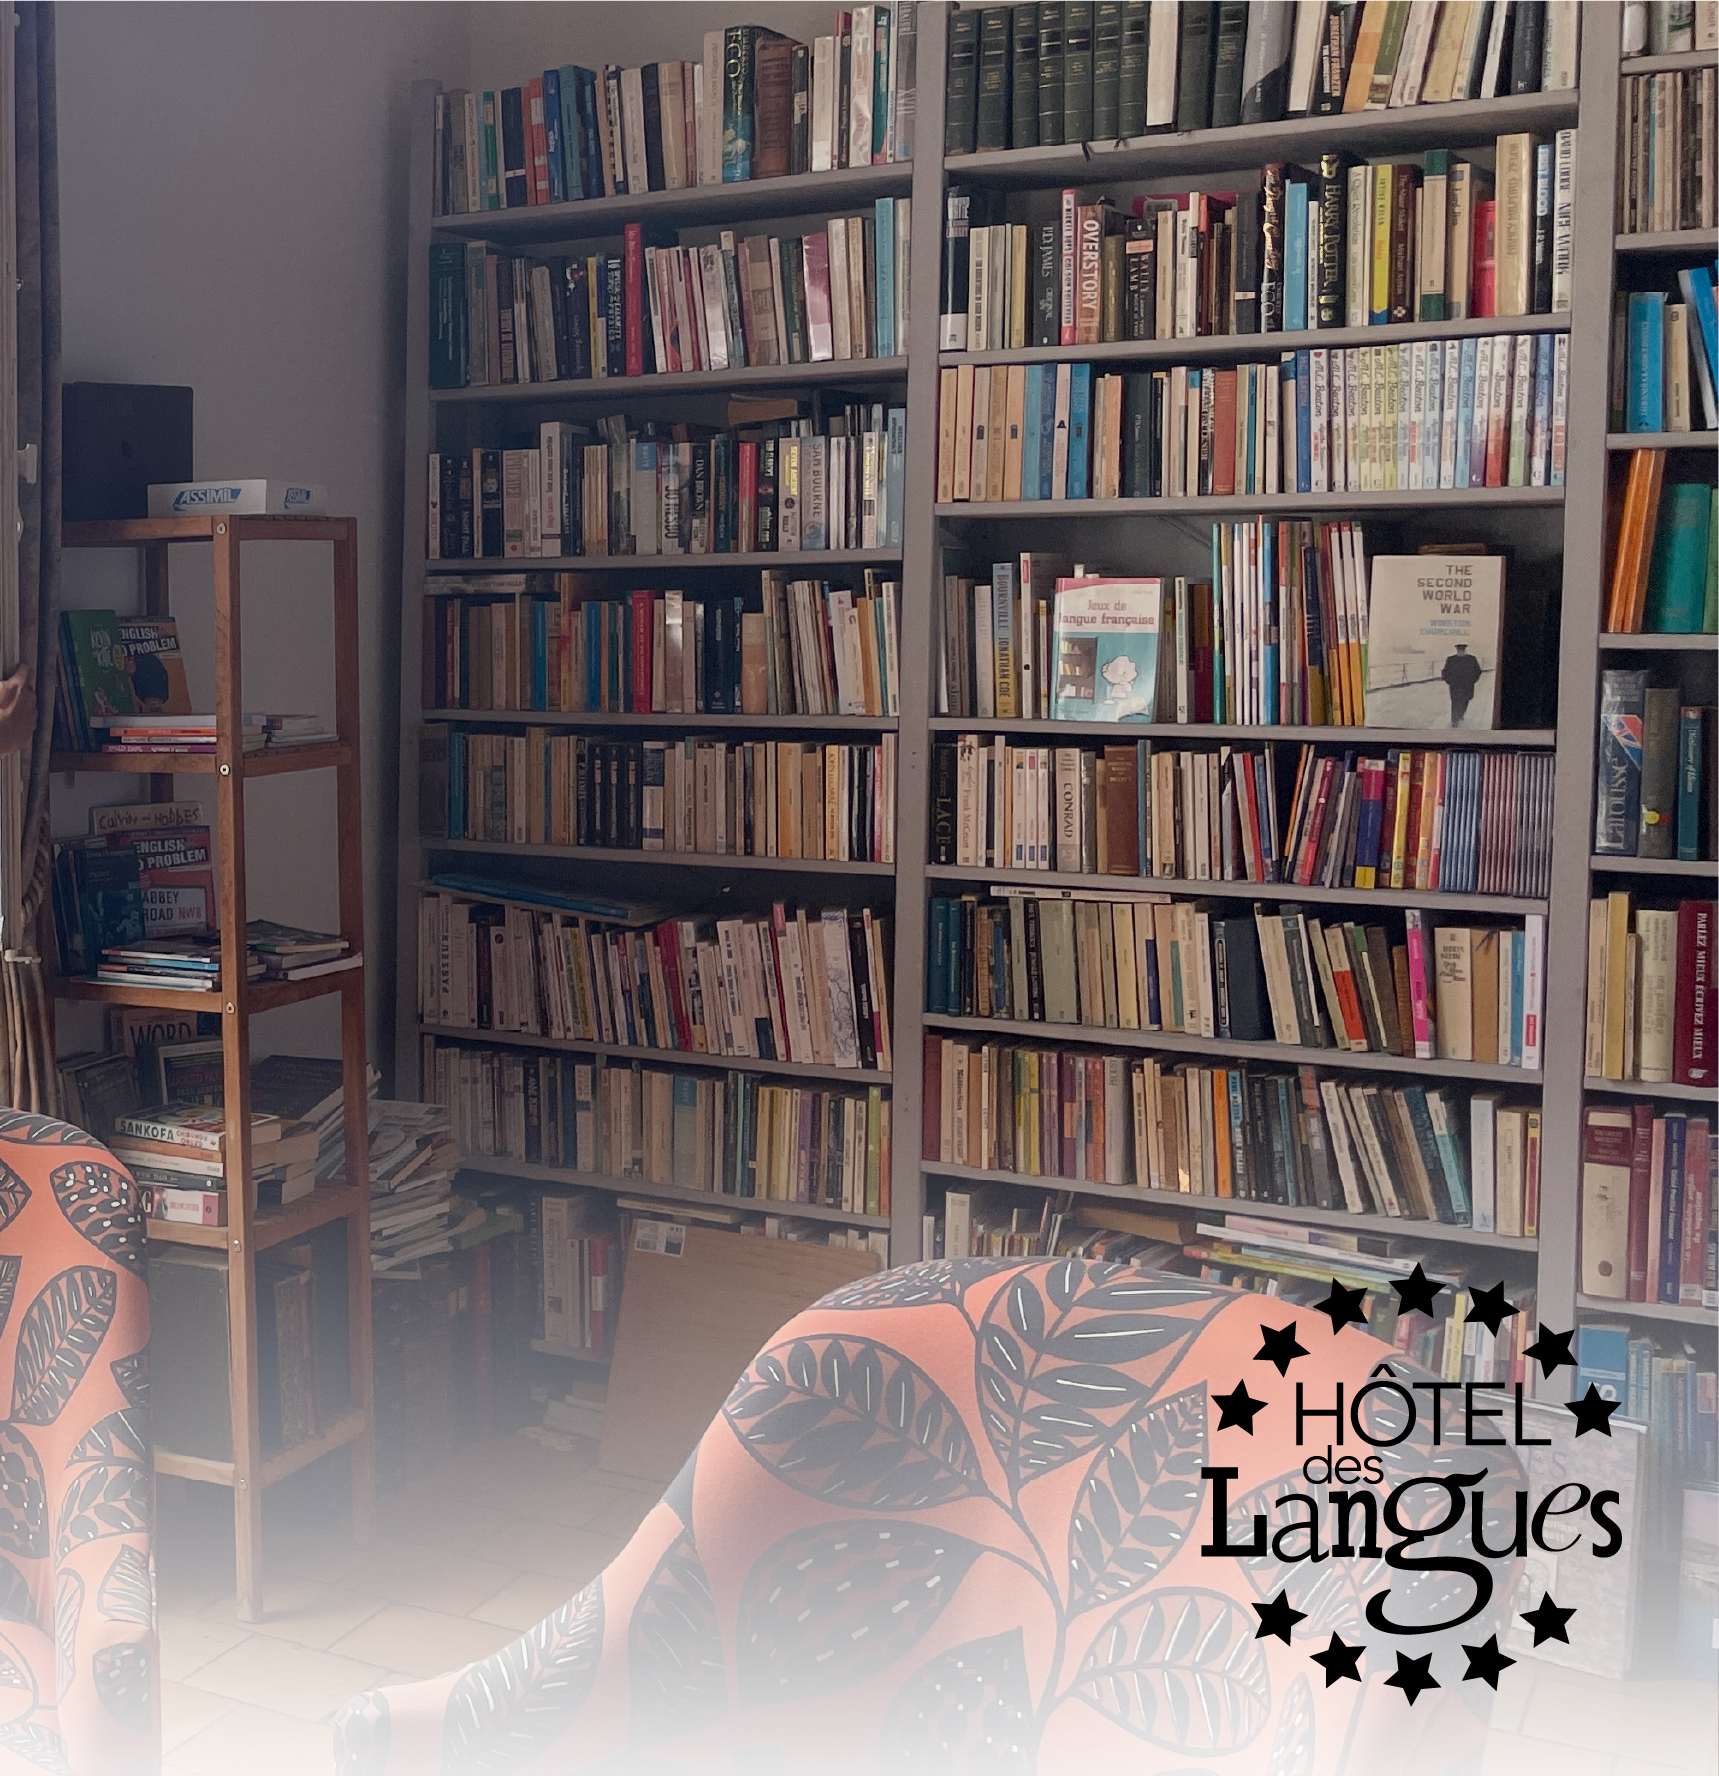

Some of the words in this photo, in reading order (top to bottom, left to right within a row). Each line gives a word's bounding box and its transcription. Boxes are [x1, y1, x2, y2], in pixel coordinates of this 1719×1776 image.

[1330, 15, 1340, 57] JONATHAN
[725, 29, 742, 78] ECO
[1331, 58, 1341, 98] FRANZEN
[1323, 183, 1341, 229] HARRY
[1351, 178, 1362, 201] Quiet
[1537, 179, 1548, 217] BLOOD
[1064, 208, 1072, 232] NICKEL
[1351, 203, 1362, 245] Revolution
[1557, 202, 1571, 230] NICE
[1040, 245, 1054, 278] JAMES
[1064, 257, 1073, 286] COLSON
[1082, 219, 1099, 310] OVERSTORY
[1130, 257, 1140, 291] LAMB
[1140, 253, 1150, 293] WALLY
[1323, 233, 1341, 287] POTTER
[1260, 281, 1276, 316] ECO
[1360, 382, 1370, 415] Beaton
[1373, 382, 1383, 415] Beaton
[1387, 380, 1397, 414] Beaton
[1399, 379, 1409, 413] Beaton
[1414, 379, 1425, 412] Beaton
[1428, 377, 1439, 412] Beaton
[1446, 376, 1457, 410] Beaton
[1462, 374, 1473, 408] Beaton
[1476, 374, 1488, 408] Beaton
[1493, 372, 1504, 408] Beaton
[1517, 372, 1528, 408] Beaton
[1536, 373, 1548, 407] Beaton
[1557, 369, 1566, 396] Beaton
[1314, 384, 1324, 417] Beaton
[1331, 385, 1342, 417] Beaton
[1347, 383, 1358, 417] Beaton
[695, 459, 705, 479] DAN
[812, 444, 823, 467] SAM
[179, 486, 236, 505] ASSIMIL
[695, 480, 705, 510] BROWN
[812, 470, 823, 517] BOURNE
[1417, 577, 1473, 588] SECOND
[1445, 565, 1474, 576] THE
[997, 574, 1010, 630] BOURNVILLE
[1087, 599, 1110, 612] Jeux
[1114, 600, 1127, 611] de
[1422, 590, 1472, 602] WORLD
[1440, 603, 1471, 615] WAR
[1101, 613, 1154, 627] française
[1419, 627, 1470, 637] CHURCHILL
[1429, 619, 1471, 628] WINSTON
[131, 637, 178, 657] PROBLEM
[998, 637, 1011, 679] JONATHAN
[999, 681, 1010, 698] COE
[962, 789, 972, 812] Frank
[1062, 782, 1074, 838] CONRAD
[1605, 757, 1630, 849] Larousse
[99, 811, 139, 830] Calvin
[936, 796, 952, 845] LACE
[962, 813, 972, 849] McCourt
[146, 849, 207, 869] PROBLEM
[143, 891, 179, 905] ABBEY
[144, 908, 174, 922] ROAD
[178, 906, 202, 919] NW8
[1696, 912, 1709, 947] PARLEZ
[1695, 949, 1708, 982] MIEUX
[1693, 984, 1709, 1026] ÉCRIVEZ
[1692, 1027, 1704, 1060] MIEUX
[121, 1121, 175, 1142] SANKOFA
